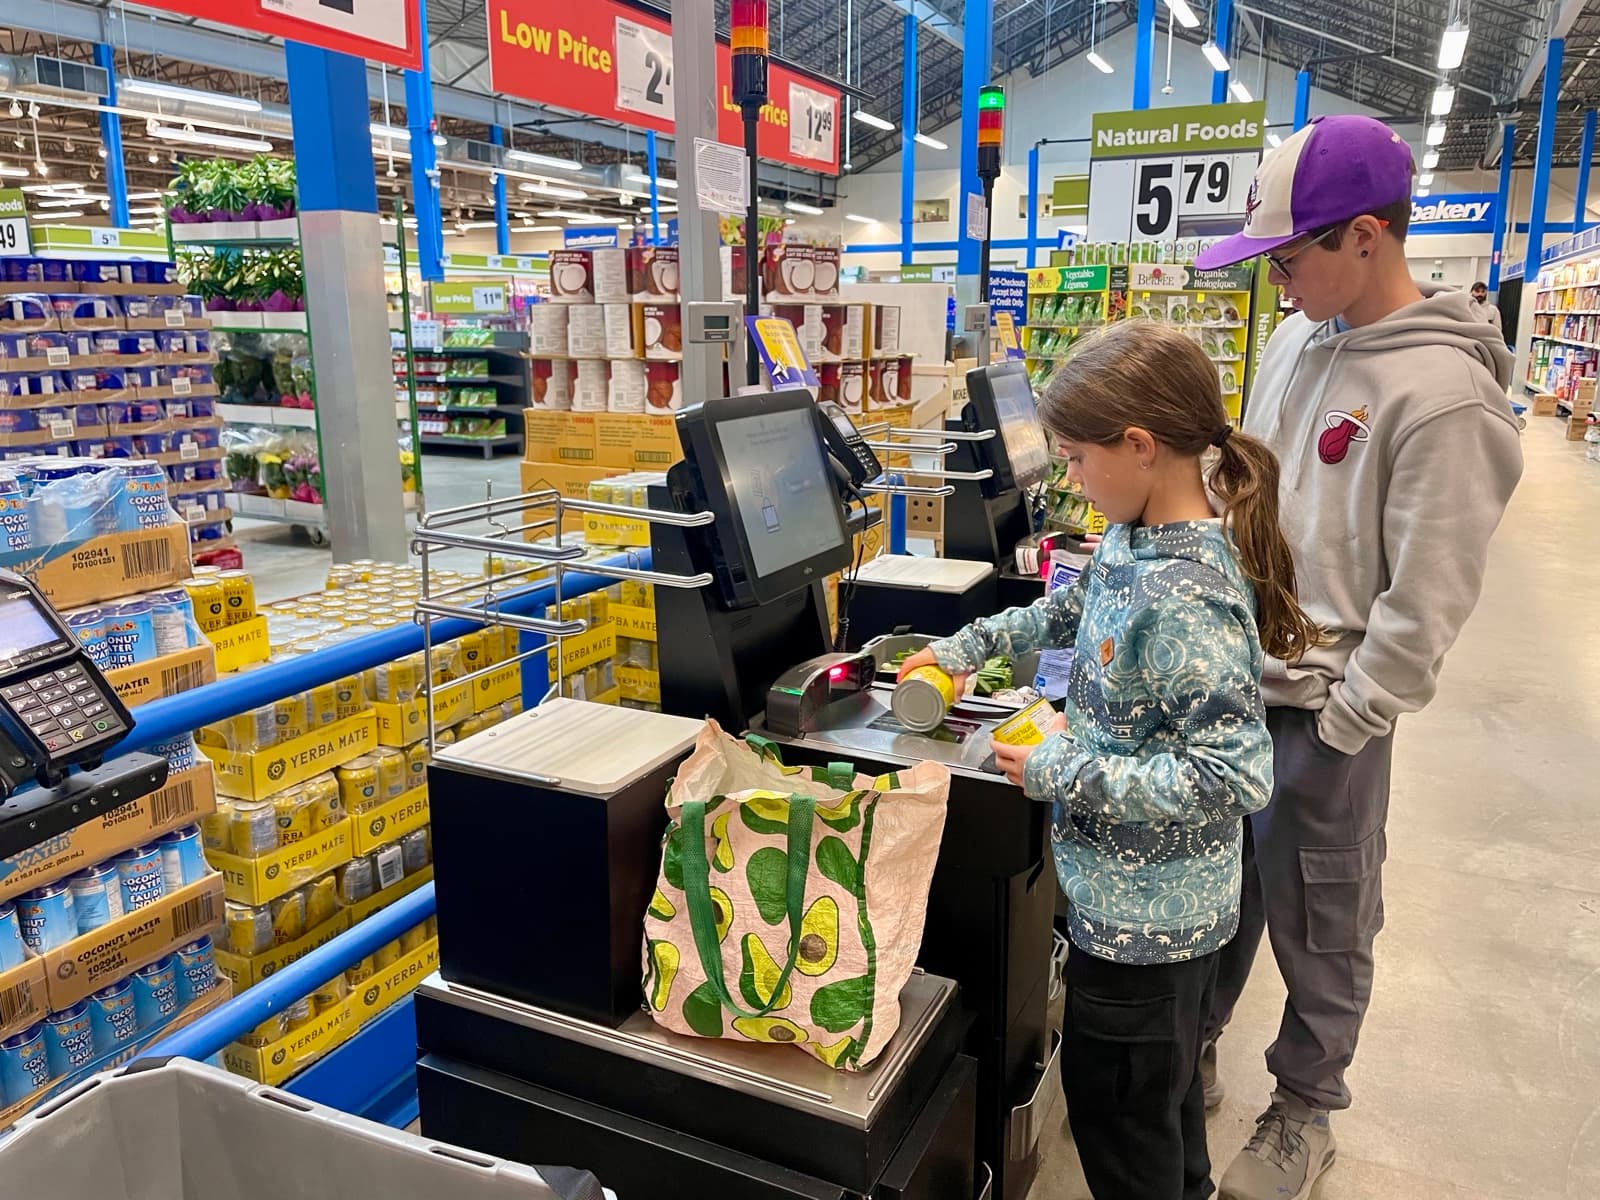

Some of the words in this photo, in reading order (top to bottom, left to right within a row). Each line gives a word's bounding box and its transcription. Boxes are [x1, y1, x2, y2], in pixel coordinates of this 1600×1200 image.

[500, 10, 551, 54] Low
[558, 32, 612, 74] Price
[1097, 123, 1179, 148] Natural
[1185, 119, 1258, 142] Foods
[0, 199, 22, 211] oods
[1410, 199, 1491, 222] bakery
[1065, 269, 1094, 279] Vegetables
[1193, 279, 1237, 289] Biologiques
[452, 295, 471, 303] Price
[992, 288, 1008, 297] Accept
[1009, 288, 1023, 296] Debit
[996, 298, 1011, 306] Credit
[71, 547, 109, 562] 102941
[216, 639, 235, 651] RBA
[238, 631, 262, 645] MATE
[563, 647, 590, 664] YERBA
[592, 636, 611, 653] MATE
[60, 671, 67, 679] 3
[69, 682, 76, 691] 6
[114, 677, 150, 693] WATER
[43, 692, 51, 700] 5
[78, 695, 86, 704] 9
[53, 705, 62, 714] 8
[27, 714, 33, 722] 7
[63, 718, 71, 726] 0
[290, 741, 335, 768] YERBA
[338, 726, 369, 749] MATE
[220, 762, 244, 776] MATE
[102, 802, 138, 820] 102941
[390, 799, 428, 825] YERBA
[17, 837, 71, 872] WATER
[284, 849, 318, 869] YERBA
[321, 834, 345, 851] MATE
[130, 892, 152, 902] EAU
[77, 934, 125, 962] COCONUT
[128, 917, 161, 937] WATER
[88, 952, 122, 976] 102941
[385, 959, 423, 991] YERBA
[290, 1026, 324, 1052] YERBA
[327, 1009, 351, 1031] MATE
